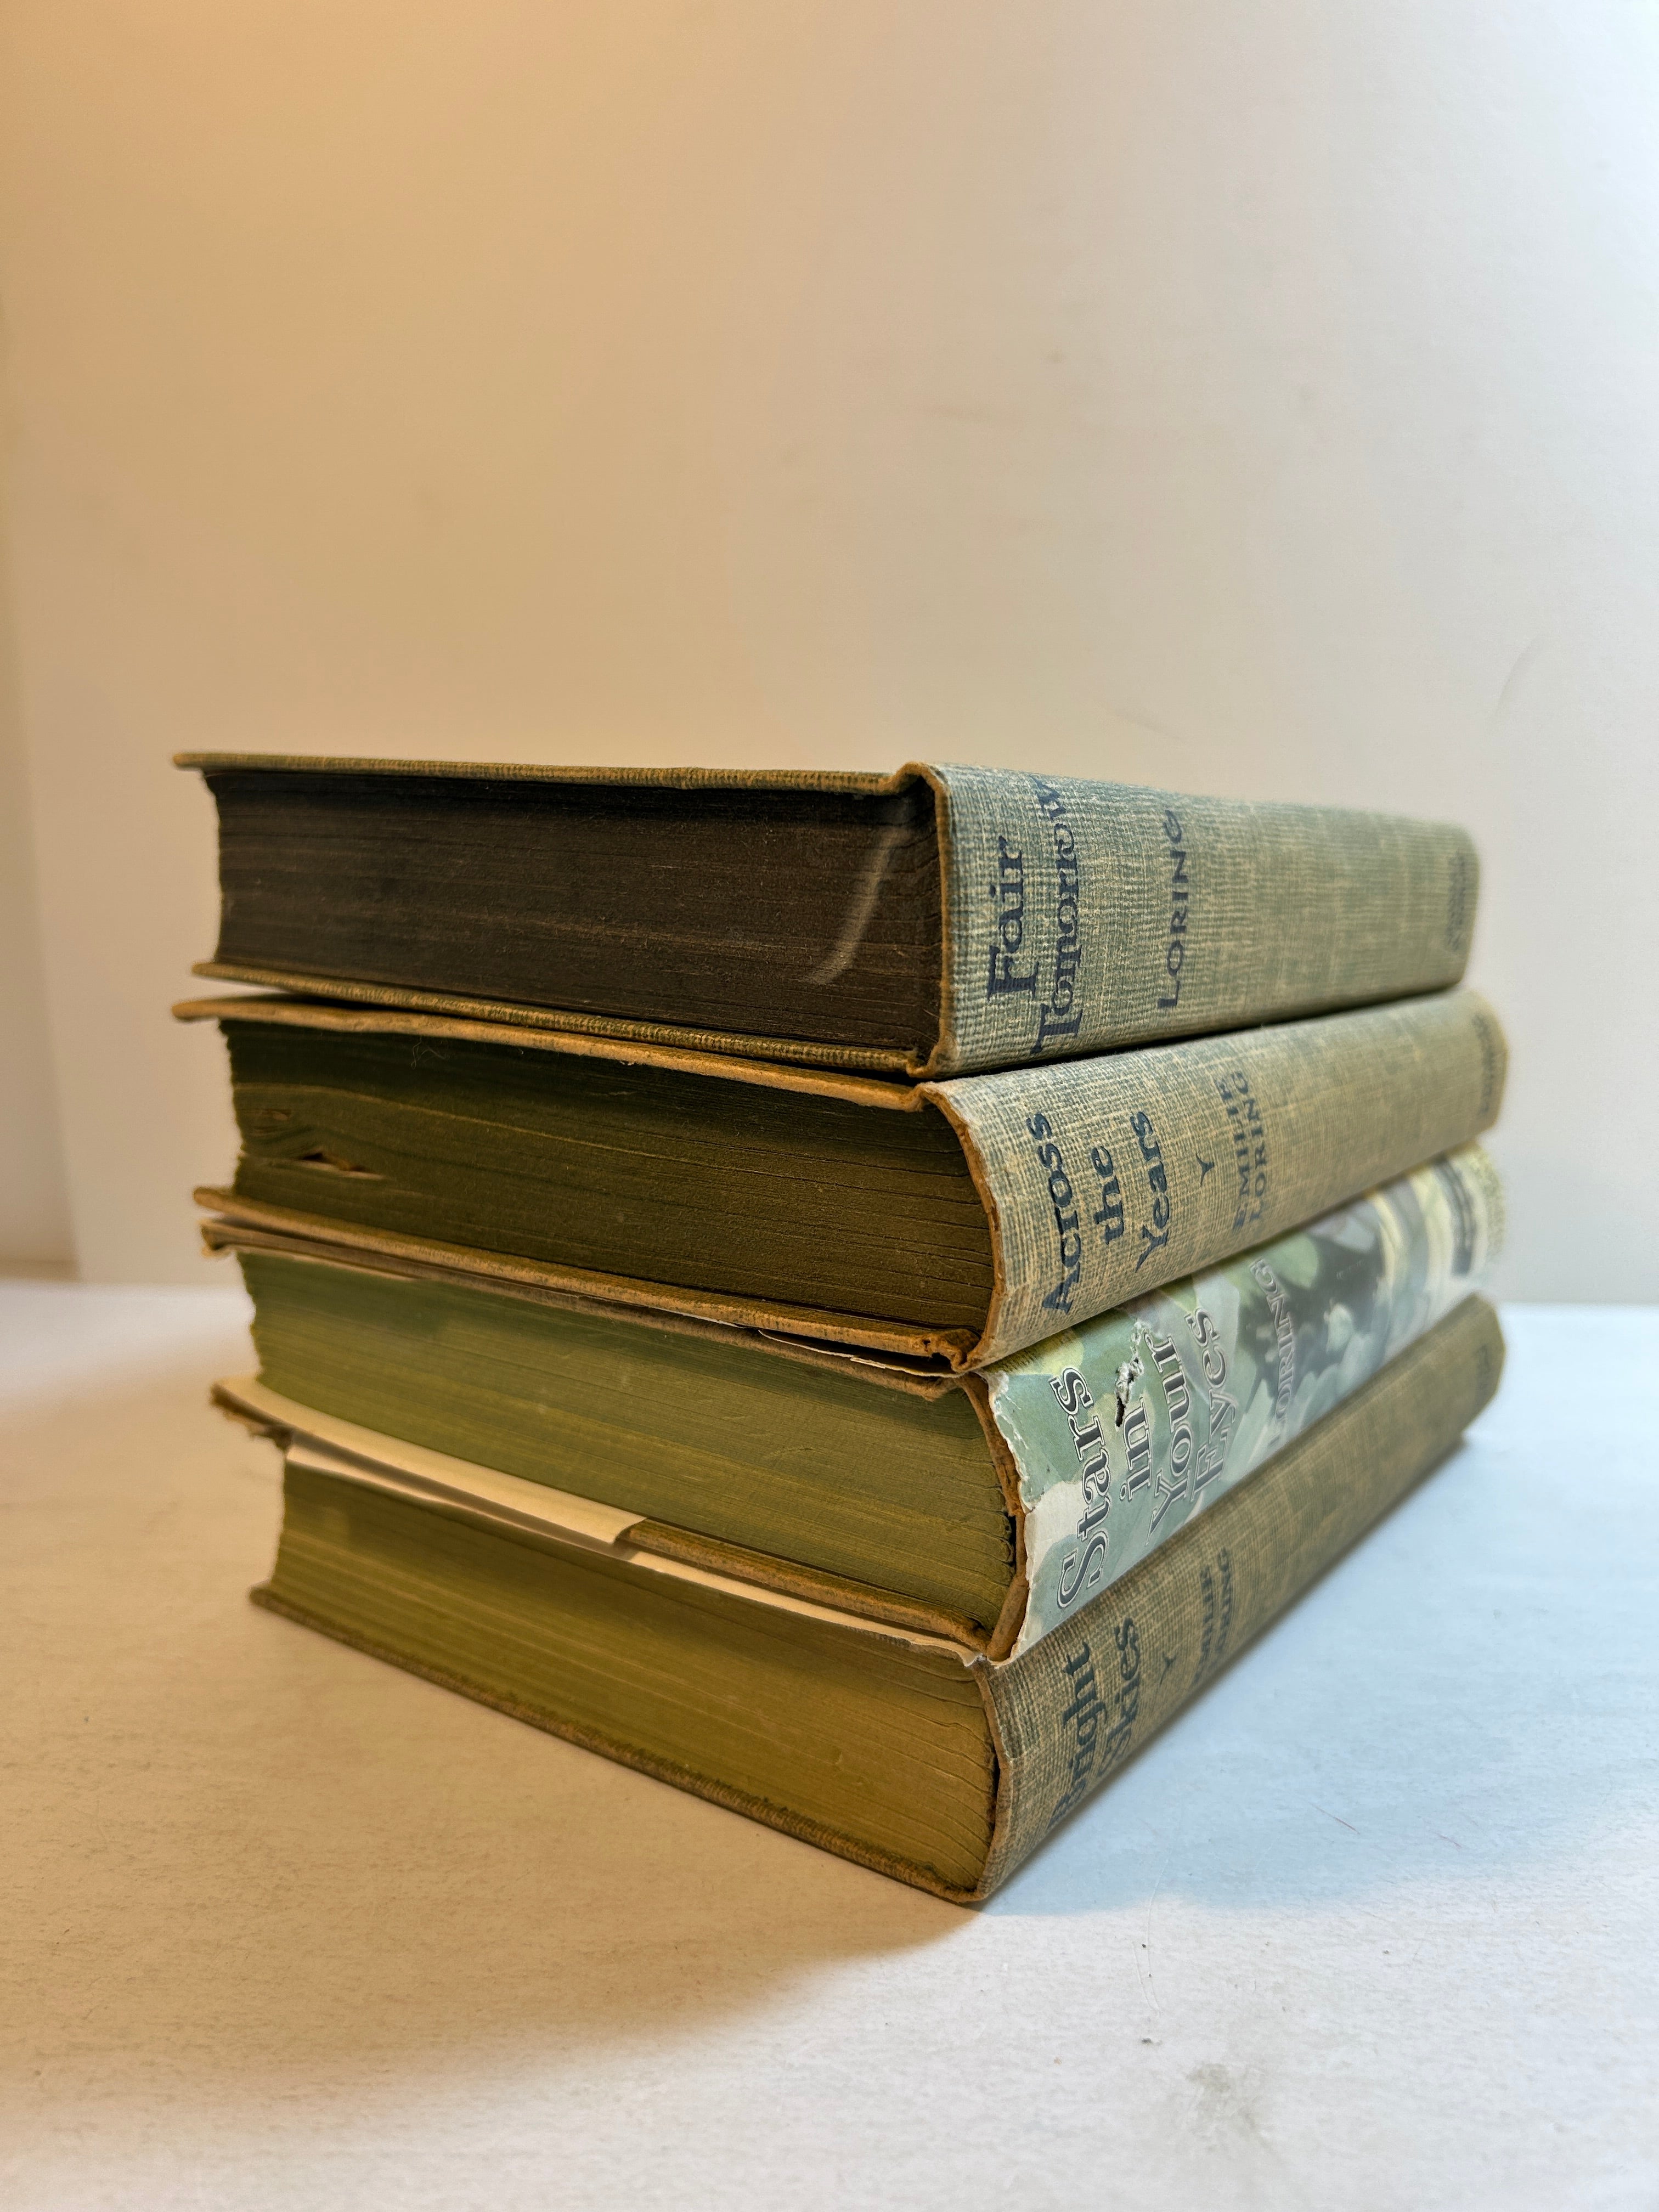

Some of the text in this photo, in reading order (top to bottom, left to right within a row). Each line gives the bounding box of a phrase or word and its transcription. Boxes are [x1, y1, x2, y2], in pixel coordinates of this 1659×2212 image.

[986, 835, 1040, 1001] Fair
[1028, 774, 1083, 1054] Tomorrow
[1157, 809, 1189, 1009] LORING
[1026, 1111, 1081, 1315] Across
[1091, 1145, 1125, 1245] the
[1130, 1110, 1170, 1273] Years
[1212, 1074, 1251, 1233] EMILIE
[1231, 1070, 1268, 1223] LORING
[1048, 1366, 1111, 1609] Stars
[1119, 1397, 1154, 1502] in
[1143, 1333, 1193, 1546] Your
[1185, 1307, 1238, 1503] Eyes
